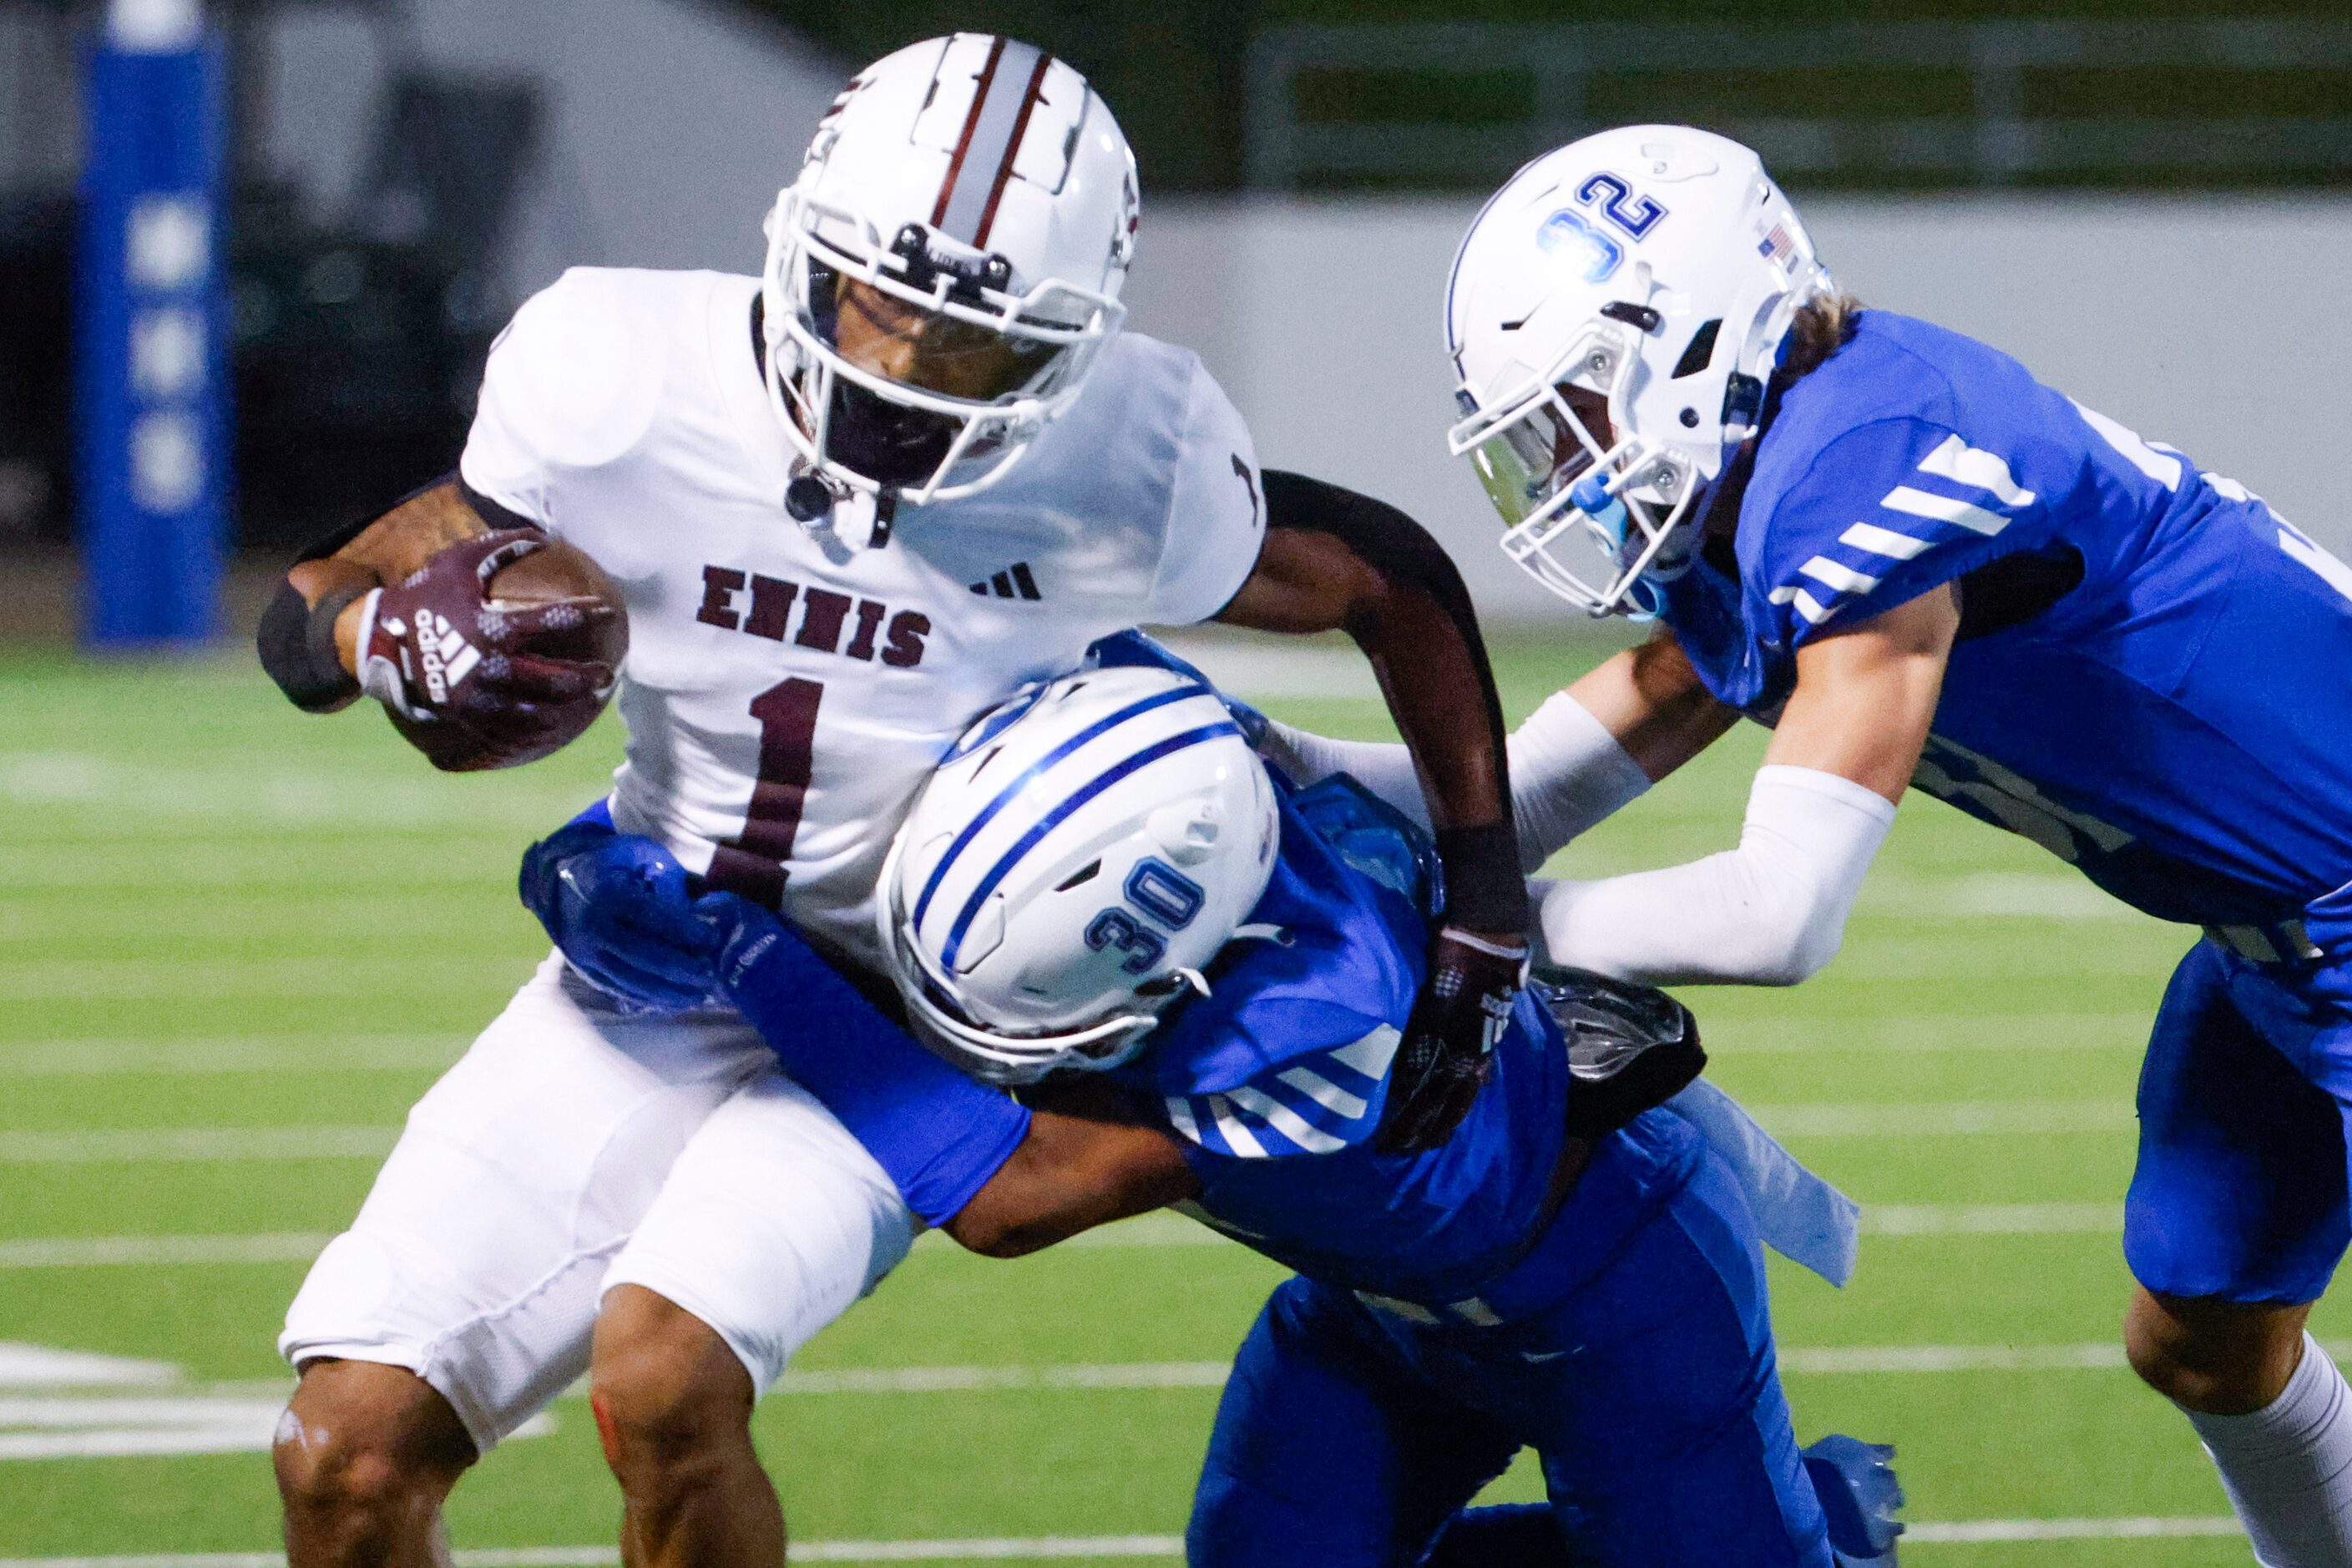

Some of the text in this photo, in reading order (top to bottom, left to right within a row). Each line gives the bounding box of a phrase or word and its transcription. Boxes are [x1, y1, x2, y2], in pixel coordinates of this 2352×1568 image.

[1536, 171, 1669, 284] 32
[696, 564, 931, 668] ENNIS
[690, 676, 824, 910] 1
[1084, 855, 1206, 975] 30
